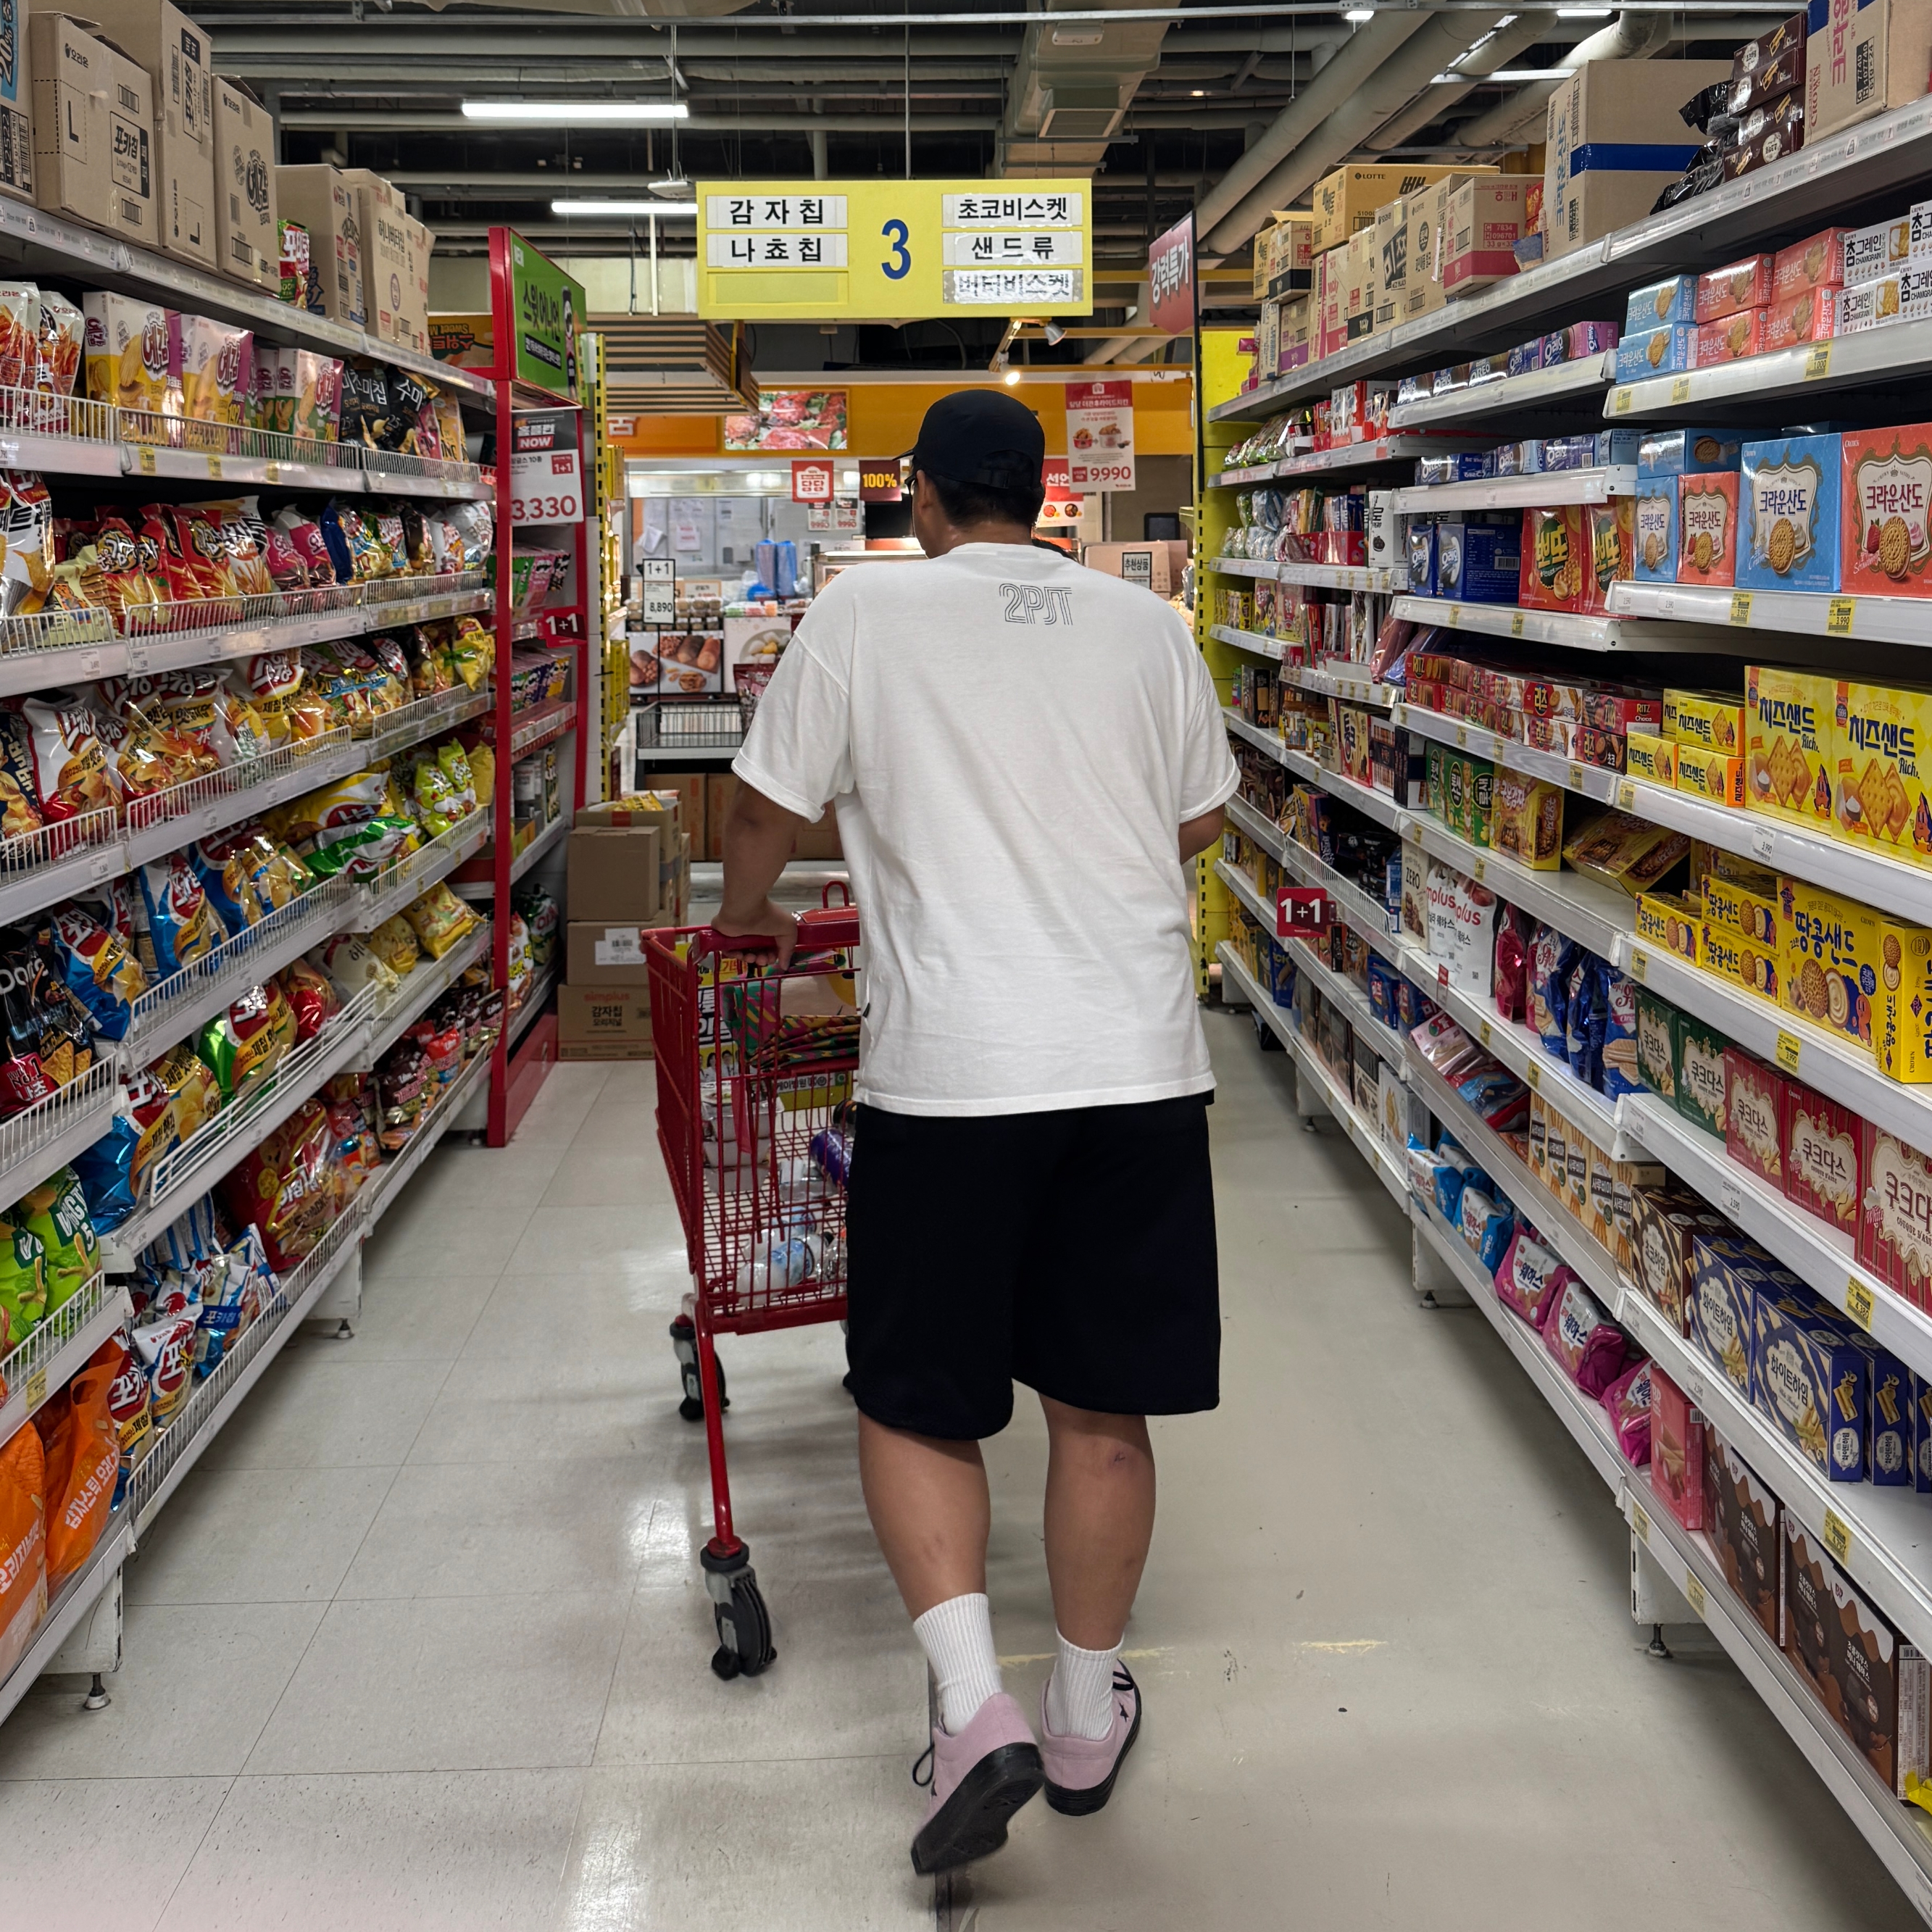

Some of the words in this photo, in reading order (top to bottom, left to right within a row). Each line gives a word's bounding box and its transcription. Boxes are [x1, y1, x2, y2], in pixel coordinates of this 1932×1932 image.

[70, 49, 89, 69] 오리온
[1811, 66, 1820, 128] CROWN
[114, 125, 138, 159] 포카칩
[958, 198, 1067, 221] 초코비스켓
[378, 218, 404, 254] 허니버터칩
[880, 219, 912, 280] 3
[1846, 234, 1881, 267] 참그레인
[1151, 231, 1189, 304] 강력특가
[1774, 261, 1802, 286] 크라운산도
[1699, 283, 1727, 306] 크라운산도
[1844, 291, 1870, 323] 참그레인
[1544, 336, 1563, 365] 오레오
[1617, 348, 1644, 368] 크라운산도
[1470, 363, 1491, 380] OREO
[520, 437, 551, 448] NOW
[554, 464, 571, 472] 1+1
[1546, 445, 1567, 467] 오레오
[863, 472, 897, 488] 100%
[1091, 467, 1131, 482] 9,990
[512, 496, 576, 522] 3,330
[1760, 488, 1807, 517] 크라운산도
[1866, 483, 1924, 512] 크라운산도
[1639, 513, 1665, 530] 크라운산도
[1688, 510, 1722, 530] 크라운산도
[1125, 558, 1149, 571] 추천상품
[649, 602, 673, 613] 8,890
[546, 614, 578, 635] 1+1
[1413, 656, 1425, 673] RITZ
[1534, 686, 1548, 711] 리츠
[1636, 704, 1650, 714] RITZ
[1678, 714, 1711, 735] 치즈샌드
[1758, 696, 1816, 735] 치즈샌드
[1848, 714, 1916, 759] 치즈샌드
[1628, 746, 1654, 767] 치즈샌드
[1679, 760, 1706, 783] 치즈샌드
[1405, 867, 1421, 890] ZERO
[1280, 898, 1321, 924] 1+1
[1708, 894, 1739, 925] 땅콩샌드
[1860, 916, 1875, 928] CROWN
[1639, 909, 1666, 939] 땅콩샌드
[1795, 911, 1857, 968] 땅콩샌드
[1708, 941, 1739, 974] 땅콩샌드
[592, 1005, 623, 1017] 감자칩
[1886, 994, 1896, 1046] 땅콩샌드
[1644, 1029, 1667, 1061] 쿠크다스
[1691, 1060, 1725, 1094] 쿠크다스
[1739, 1097, 1769, 1138] 쿠크다스
[1802, 1137, 1847, 1179] 쿠크다스
[1592, 1178, 1612, 1194] 사루비아
[1644, 1238, 1667, 1276] 초코하임
[1518, 1262, 1544, 1291] 웨하스
[1702, 1291, 1733, 1336] 화이트하임
[1562, 1315, 1589, 1345] 웨하스
[1770, 1354, 1809, 1406] 화이트하임
